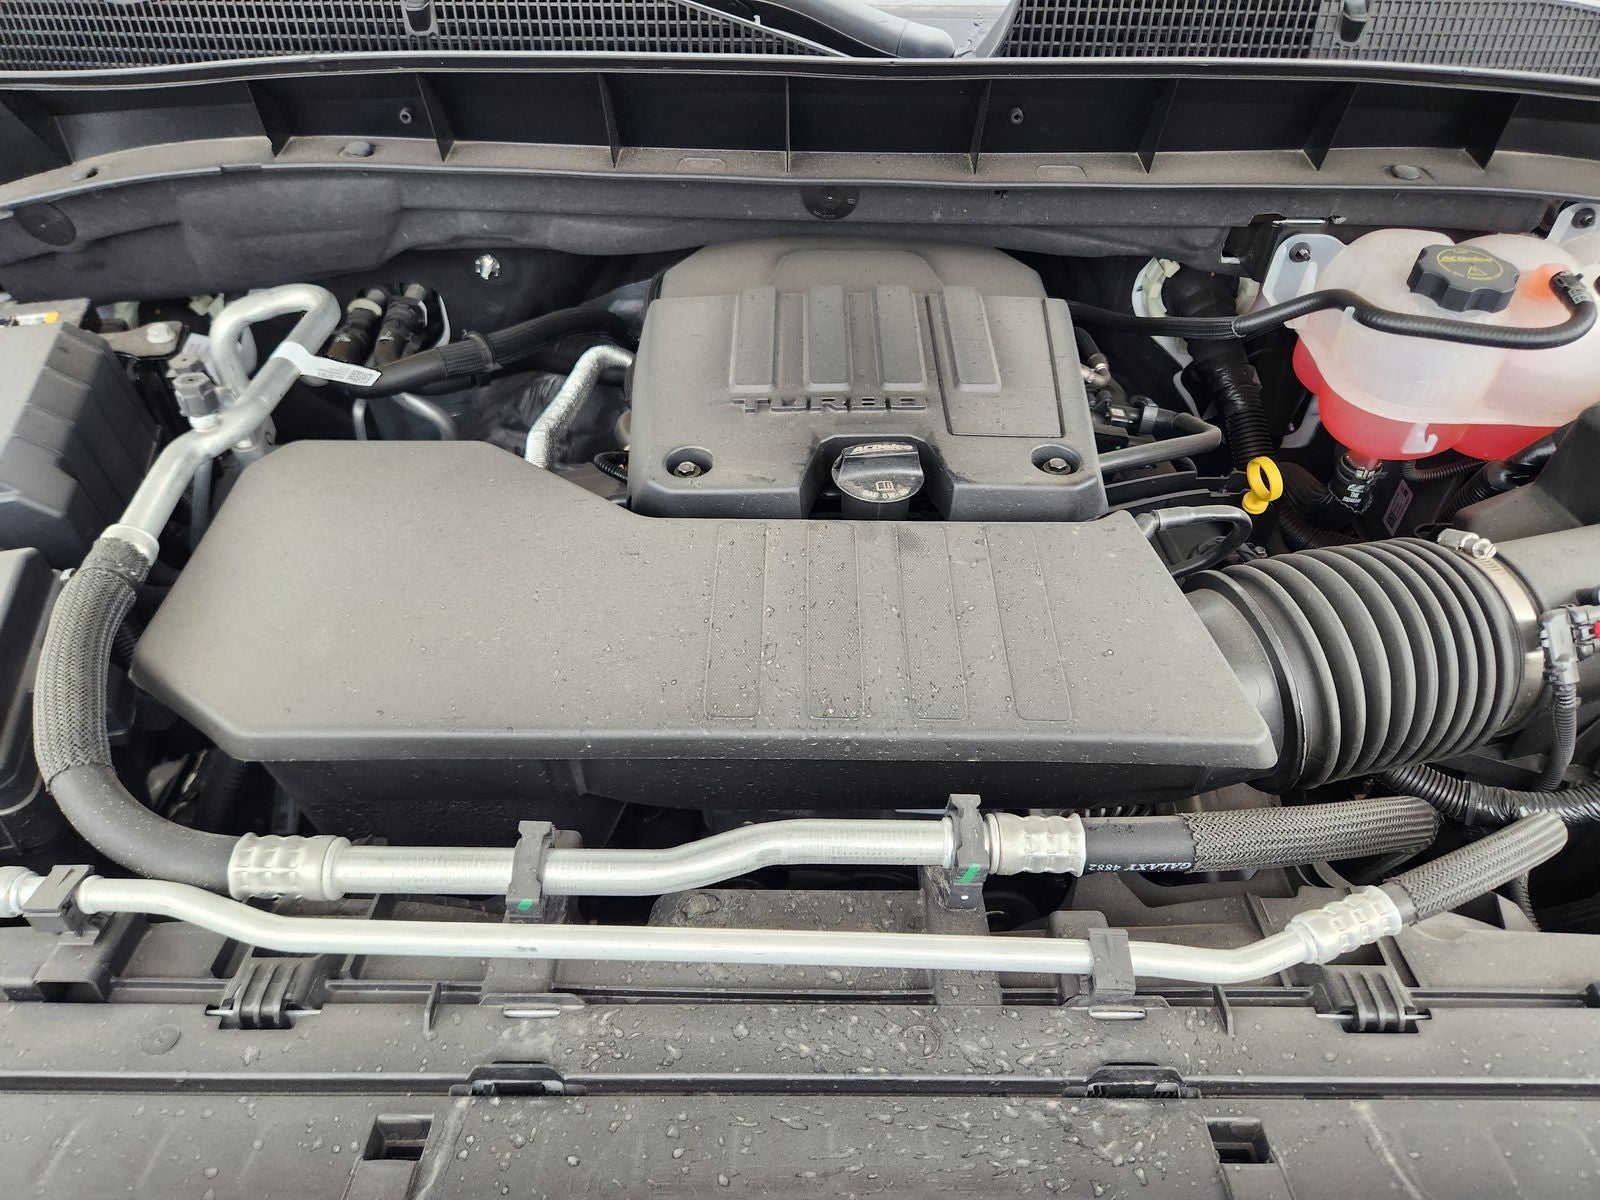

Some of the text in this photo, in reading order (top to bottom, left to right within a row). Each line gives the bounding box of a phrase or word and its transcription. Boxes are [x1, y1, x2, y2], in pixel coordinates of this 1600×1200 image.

[731, 397, 927, 413] TURBO
[850, 443, 914, 455] ACDelco
[1088, 862, 1192, 872] GALAXY 4882
